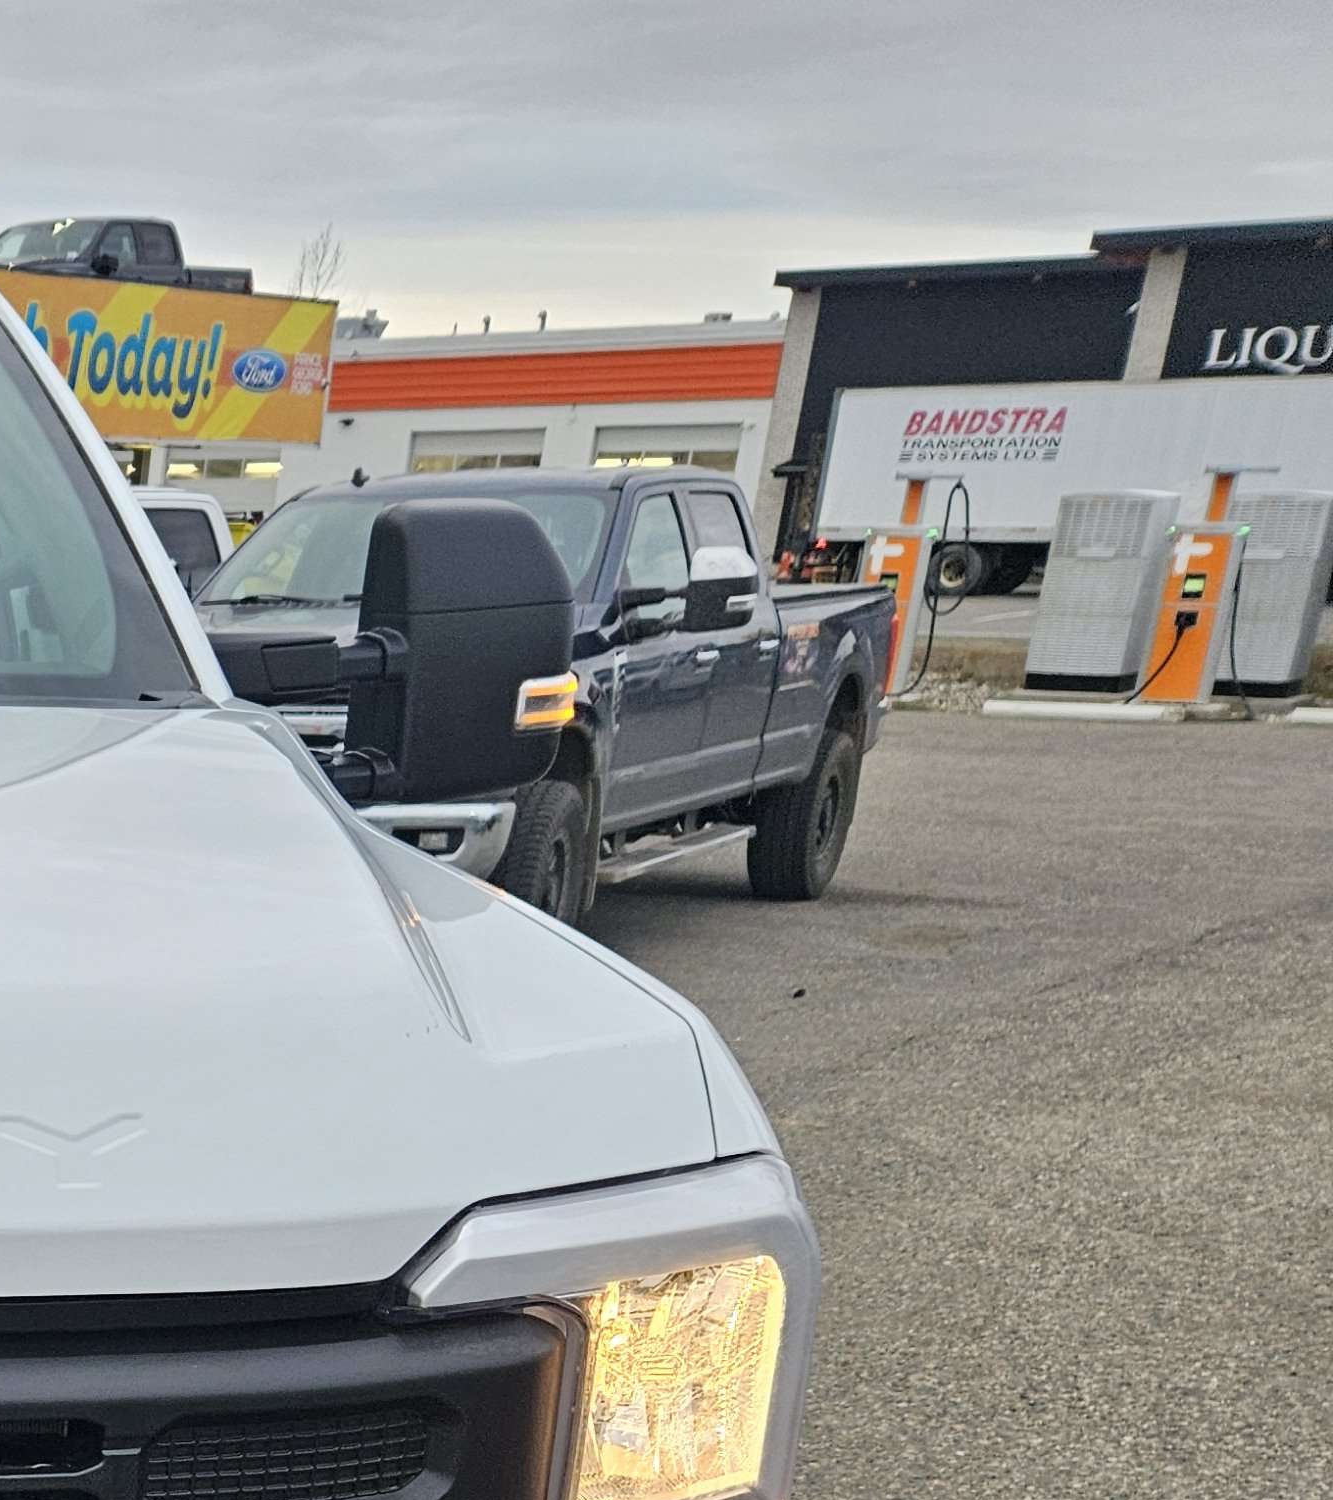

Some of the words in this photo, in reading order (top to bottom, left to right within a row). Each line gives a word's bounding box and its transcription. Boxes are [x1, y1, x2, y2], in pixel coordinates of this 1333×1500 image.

[67, 310, 223, 419] Today!
[241, 355, 279, 386] Ford
[903, 406, 1069, 436] BANDSTRA
[902, 436, 1062, 449] TRANSPORTATION
[916, 450, 998, 462] SYSTEMS
